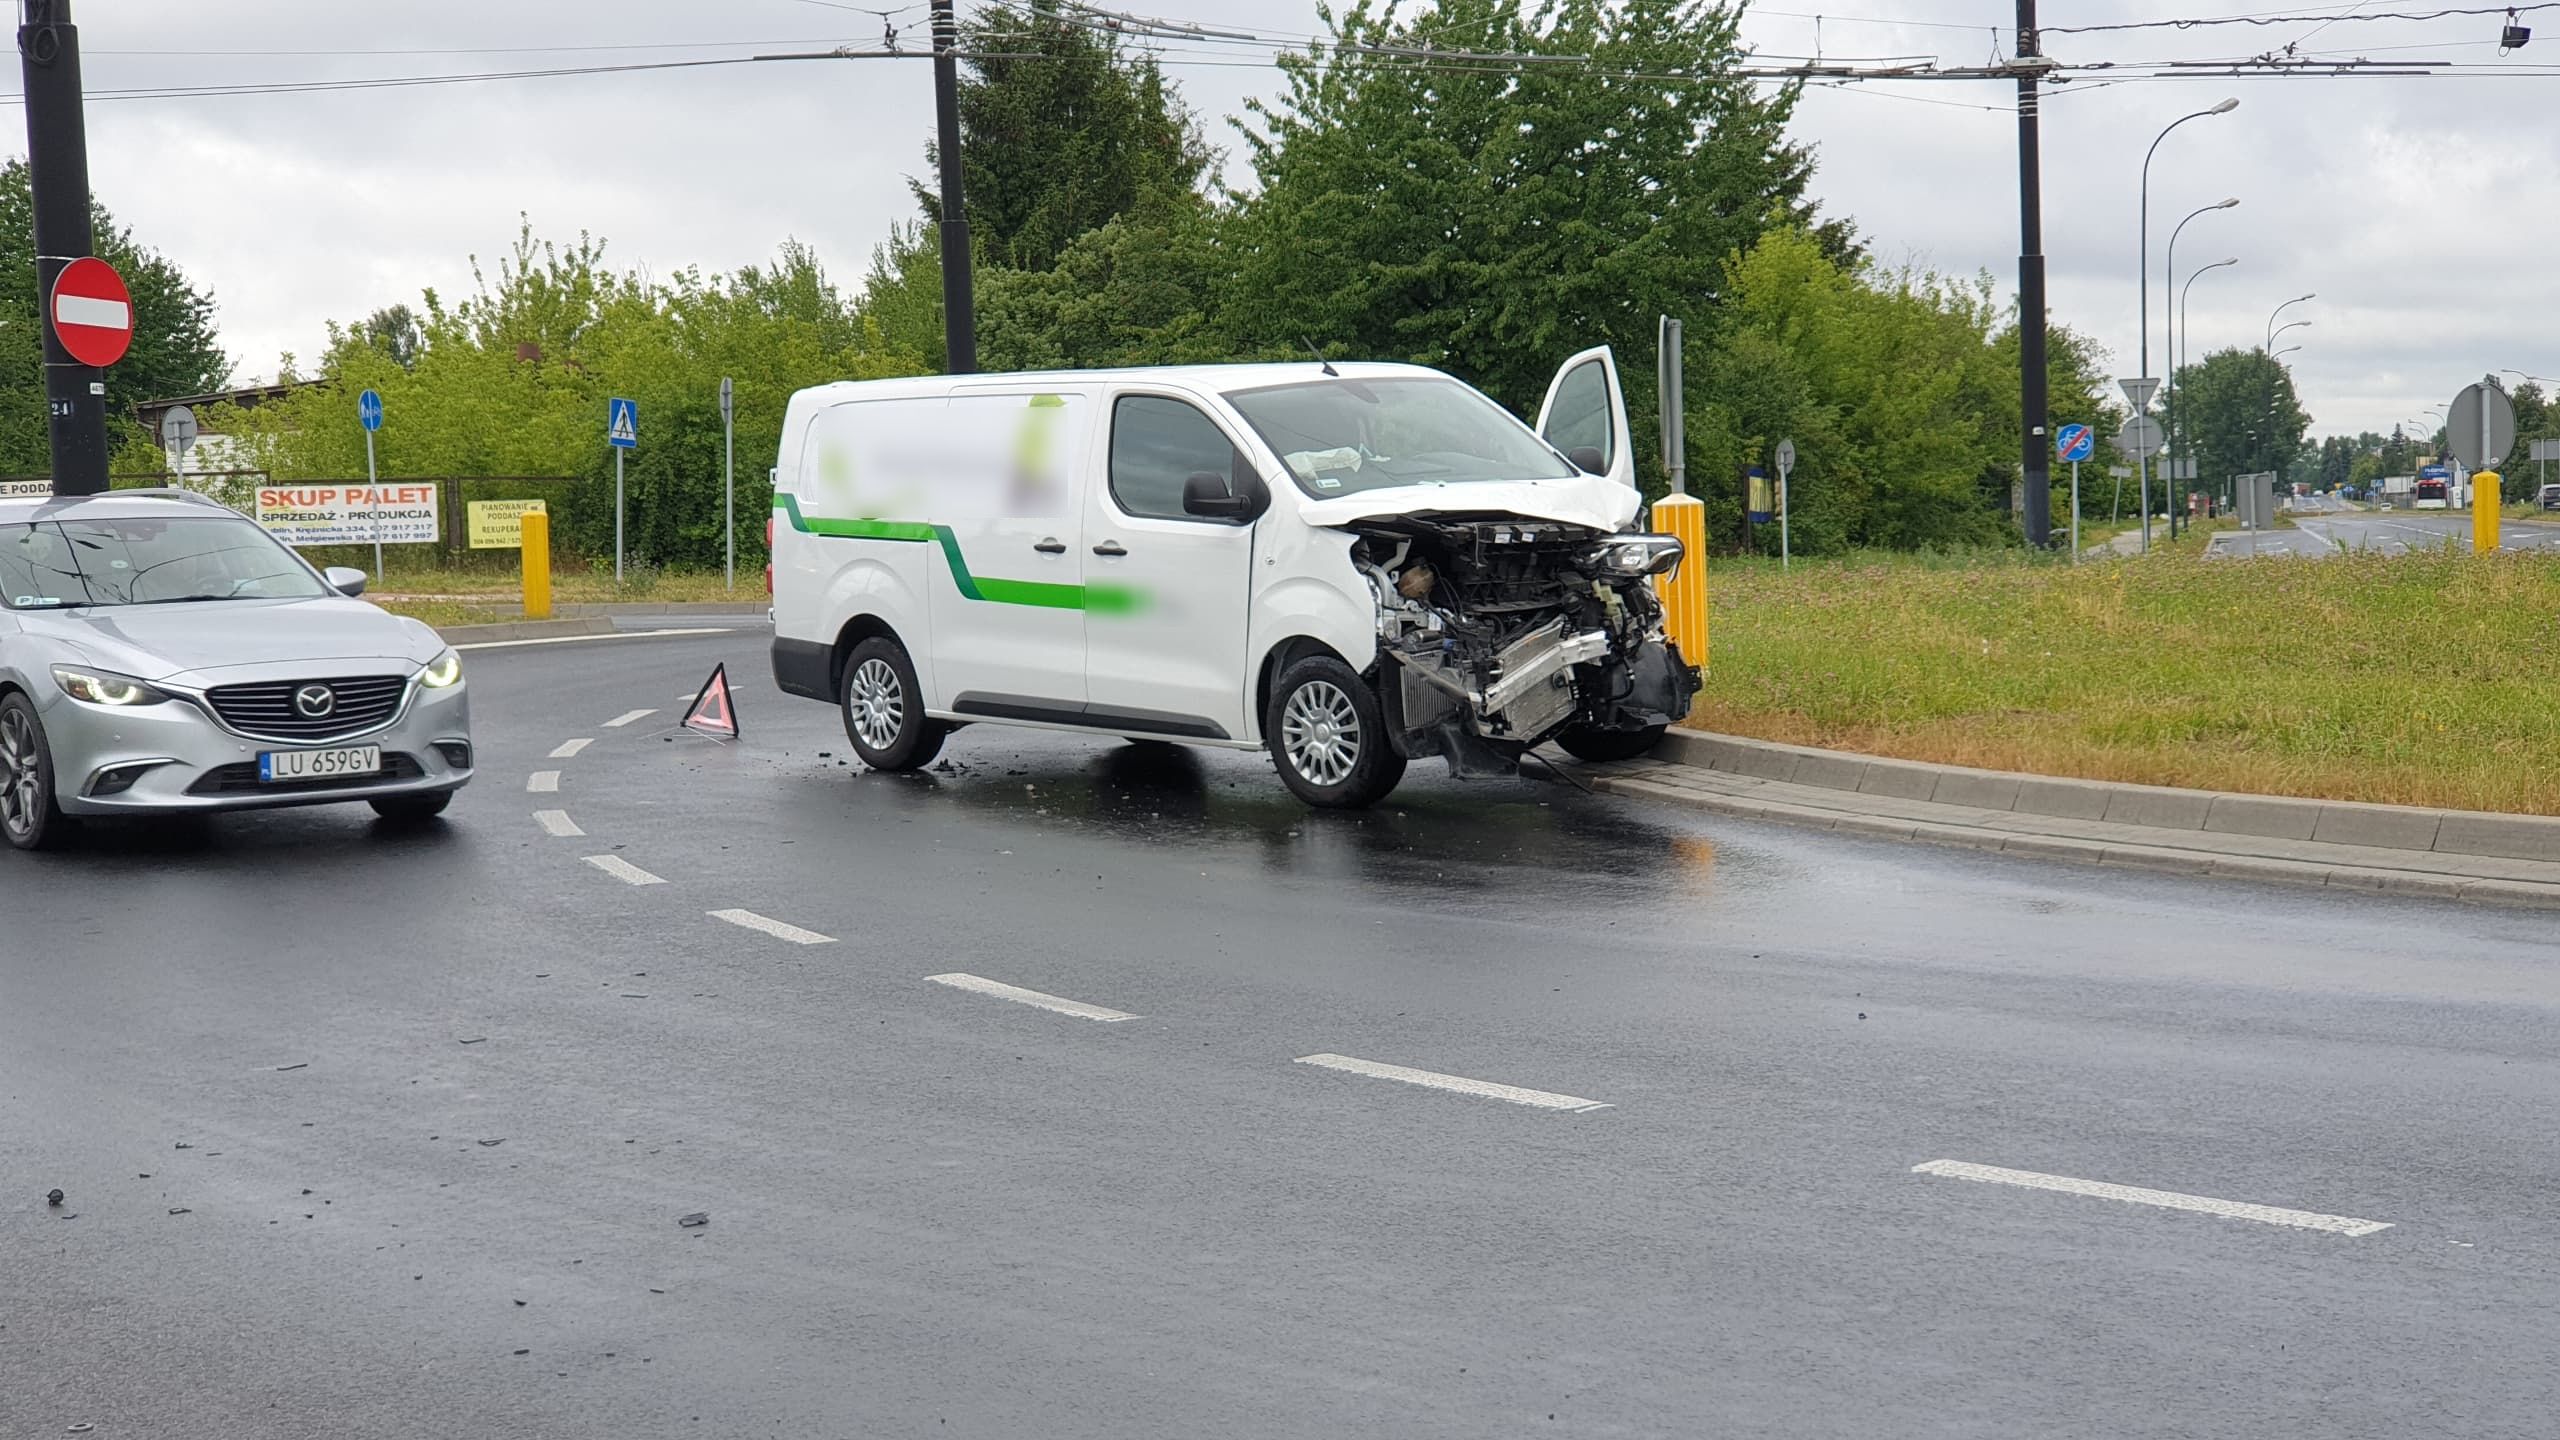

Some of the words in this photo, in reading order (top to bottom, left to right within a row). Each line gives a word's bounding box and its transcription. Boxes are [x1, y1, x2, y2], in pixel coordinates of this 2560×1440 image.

[259, 489, 337, 507] SKUP
[345, 487, 432, 505] PALET
[261, 510, 336, 522] SPRZEDAŻ
[348, 510, 432, 520] PRODUKCJA
[482, 525, 522, 533] REKUPERA
[276, 753, 303, 776] LU
[312, 749, 374, 773] 659GV
